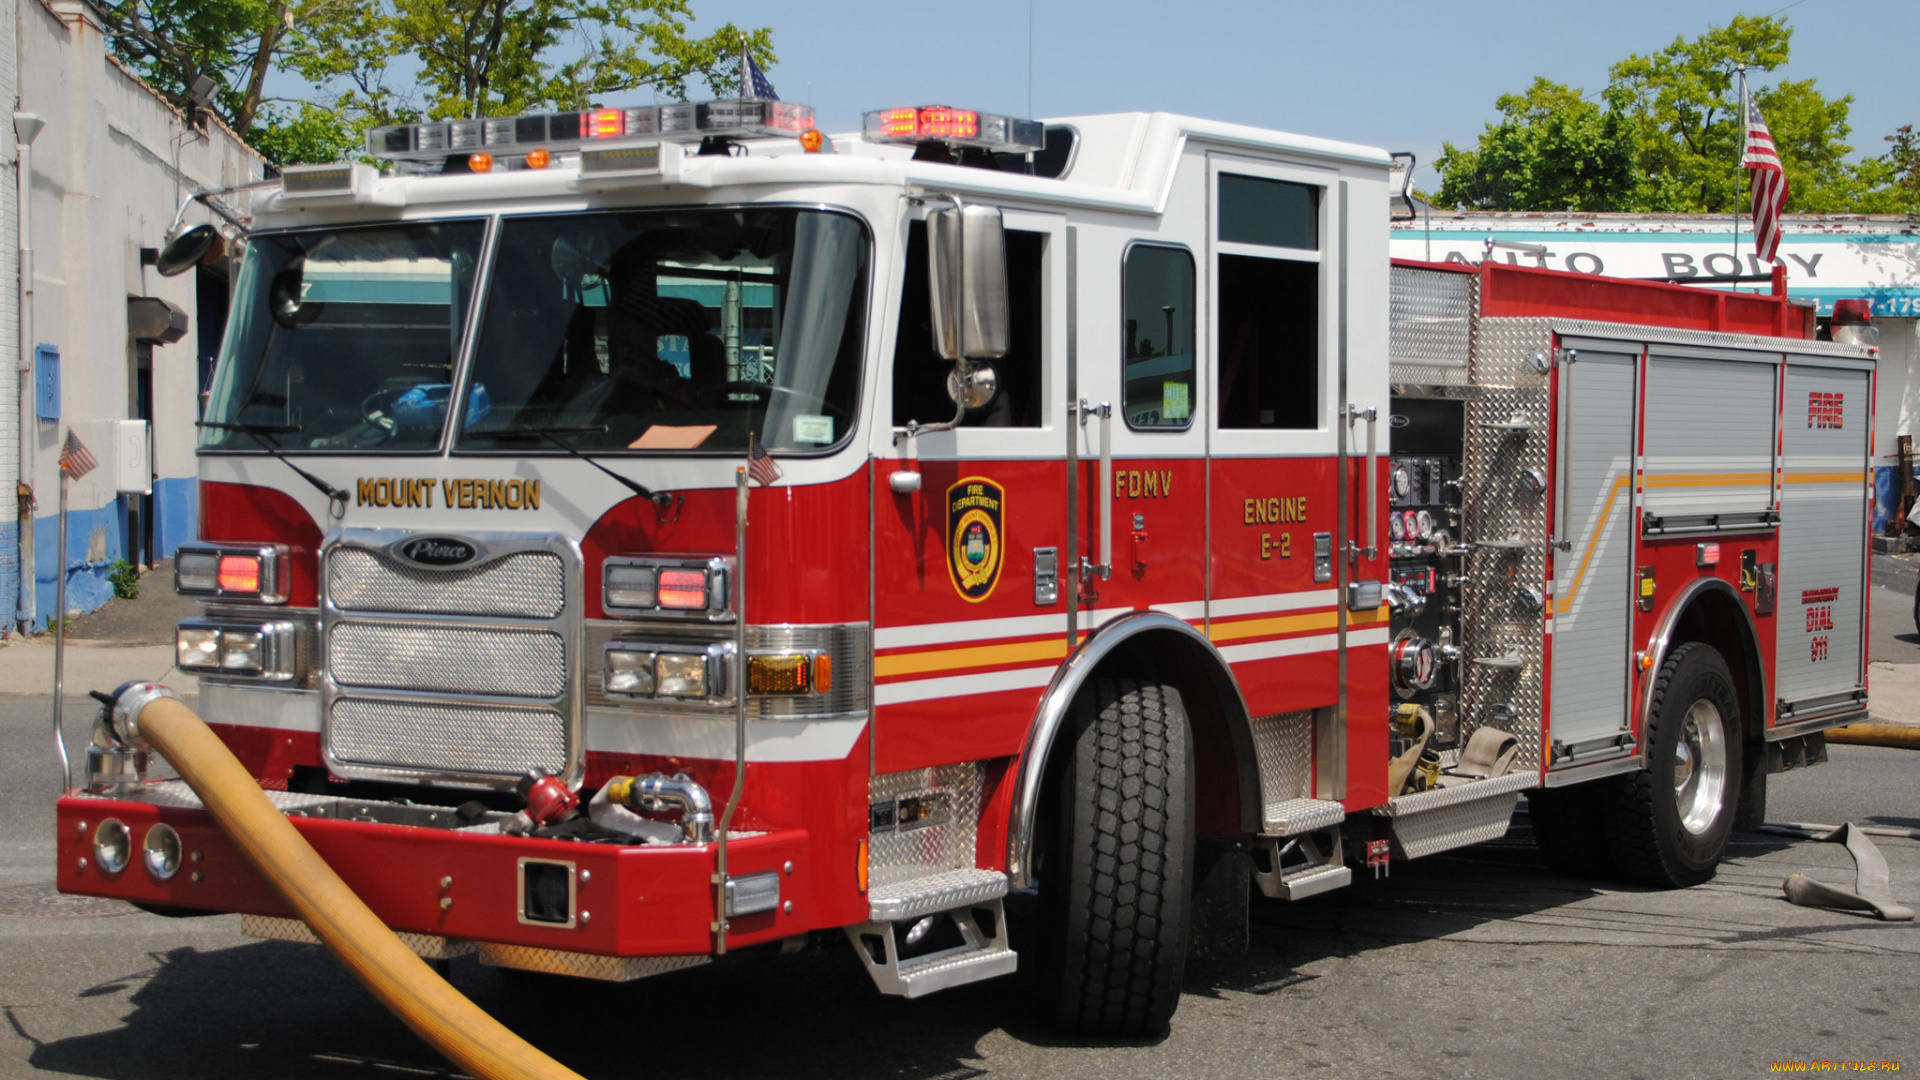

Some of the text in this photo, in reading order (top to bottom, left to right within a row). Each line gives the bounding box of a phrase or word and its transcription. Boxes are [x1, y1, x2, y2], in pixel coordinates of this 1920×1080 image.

[1808, 392, 1844, 429] FIRE
[358, 477, 540, 510] MOUNT VERNON
[967, 484, 984, 495] FIRE
[1115, 470, 1172, 498] FDMV
[952, 496, 999, 512] DEPARTMENT
[1244, 497, 1306, 524] ENGINE
[410, 540, 467, 559] Pierce
[1261, 532, 1291, 559] E-2
[1806, 605, 1834, 632] DIAL
[1811, 635, 1828, 662] 911
